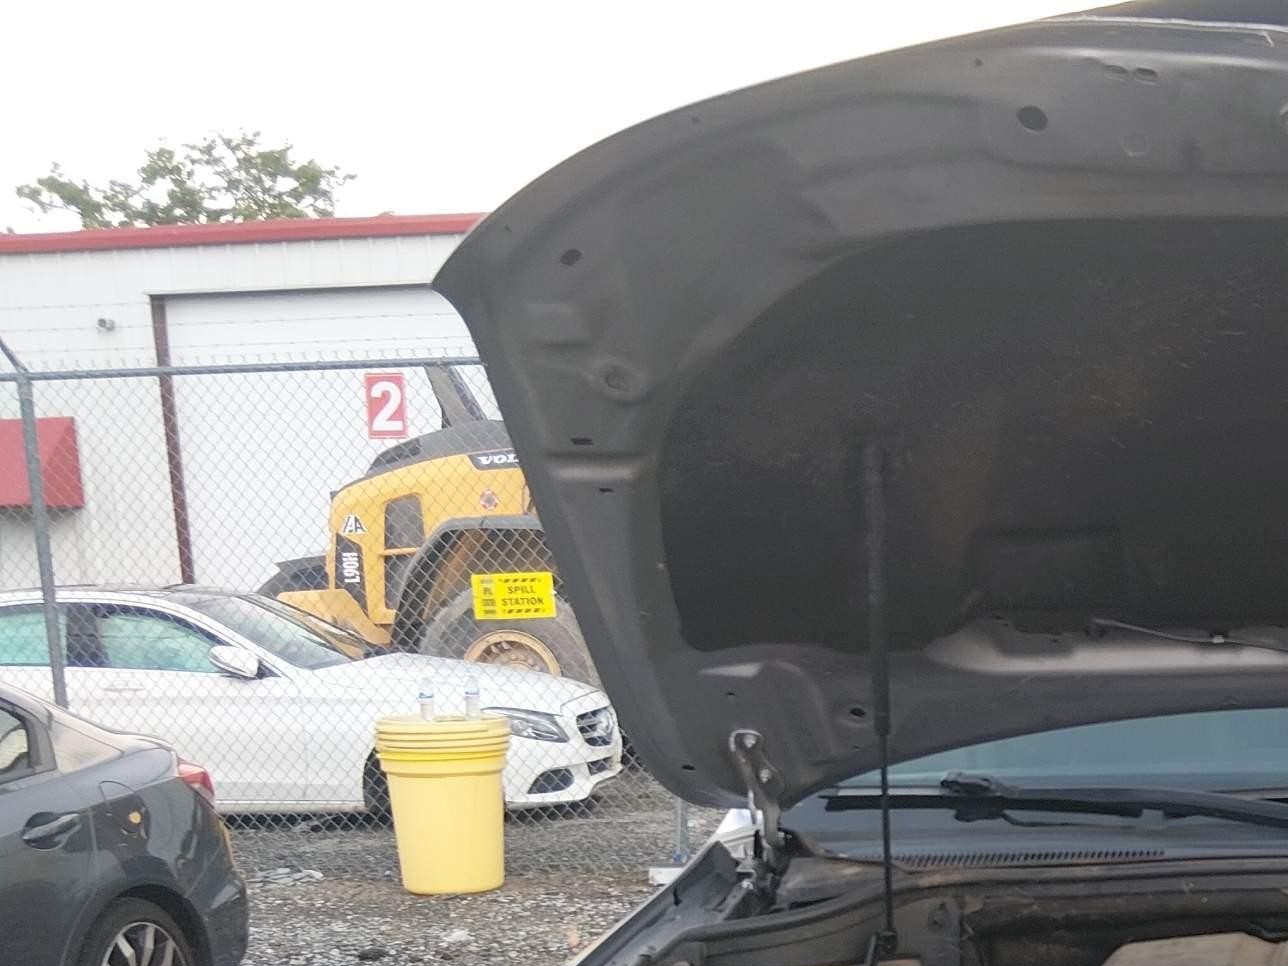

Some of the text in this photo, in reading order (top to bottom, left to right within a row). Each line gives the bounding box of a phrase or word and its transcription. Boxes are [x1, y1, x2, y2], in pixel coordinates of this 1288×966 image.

[370, 380, 404, 432] 2
[341, 551, 361, 584] L90H
[507, 585, 537, 594] SPILL
[501, 597, 545, 607] STATION
